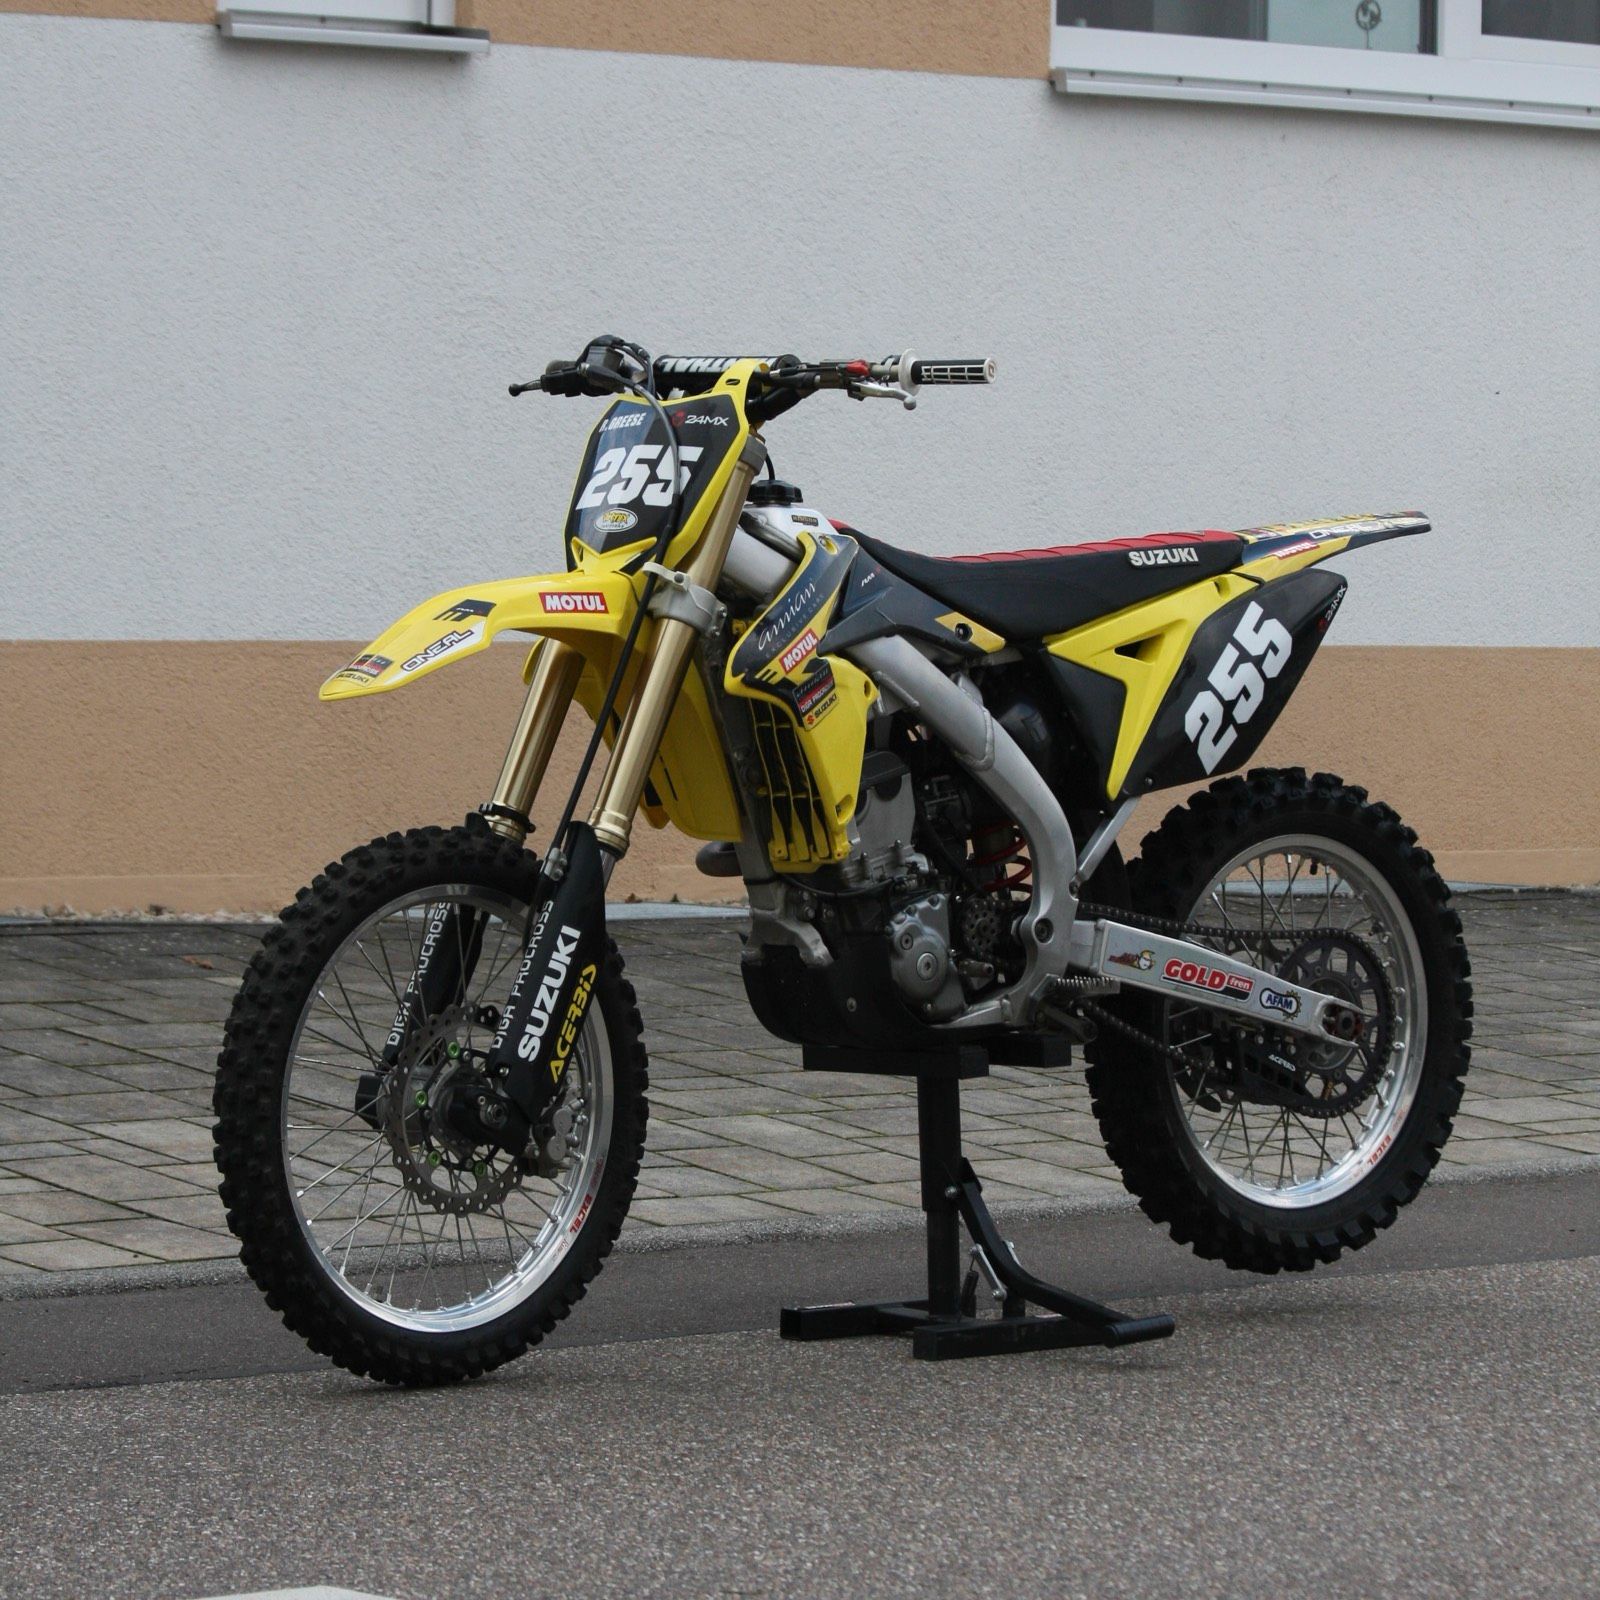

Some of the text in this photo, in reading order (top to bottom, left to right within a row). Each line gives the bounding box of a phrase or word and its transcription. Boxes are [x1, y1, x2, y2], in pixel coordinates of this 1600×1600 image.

[685, 414, 729, 427] 24MX
[575, 445, 704, 511] 255
[1128, 547, 1199, 567] SUZUKI
[544, 595, 606, 611] MOTUL
[782, 633, 818, 671] MOTUL
[1184, 600, 1293, 776] 255
[814, 693, 838, 719] SUZUKI
[491, 900, 554, 1048] DIGA PROCROSS
[1165, 959, 1227, 990] GOLD
[1229, 977, 1251, 991] fren
[517, 925, 581, 1063] SUZUKI
[1265, 993, 1293, 1010] AFAM
[569, 1193, 593, 1234] EXCEL
